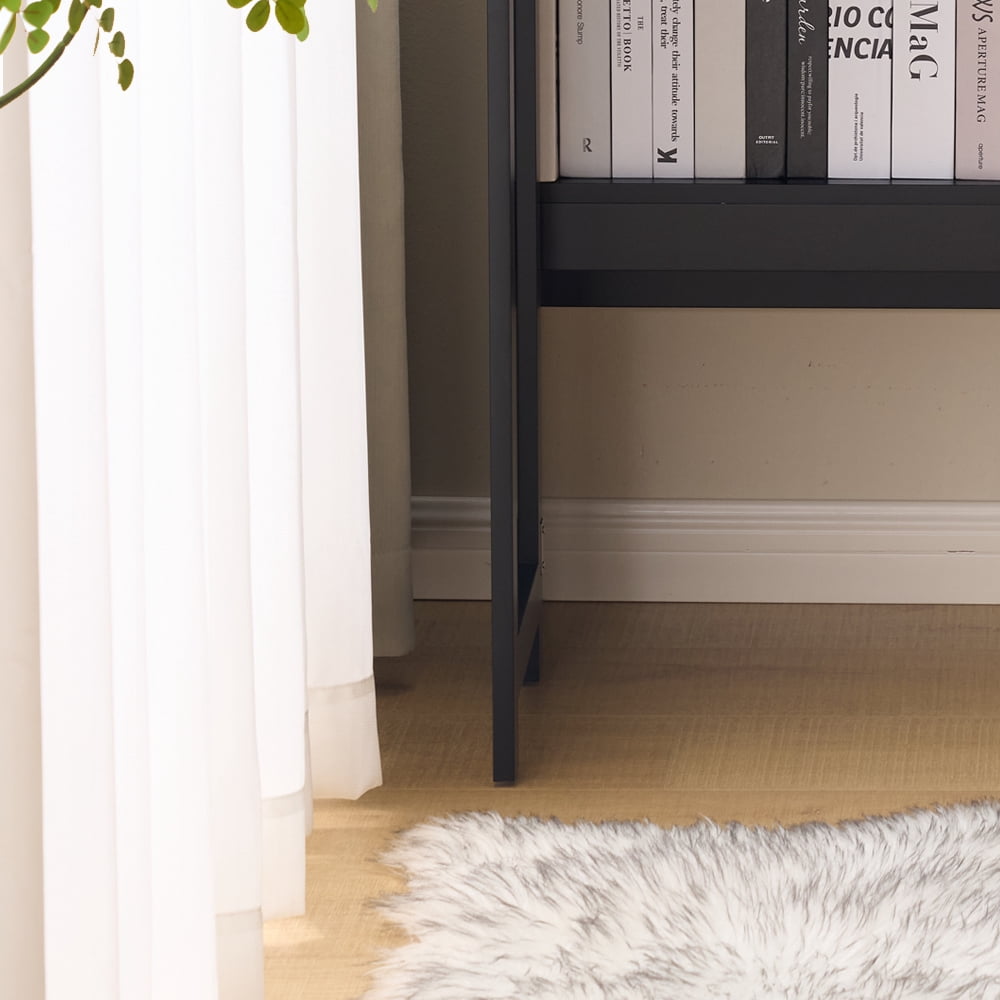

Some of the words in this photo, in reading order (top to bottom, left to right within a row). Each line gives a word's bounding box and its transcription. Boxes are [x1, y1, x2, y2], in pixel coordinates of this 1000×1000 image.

[660, 6, 669, 25] treat
[576, 22, 585, 45] Stump
[660, 29, 669, 49] their
[670, 17, 681, 47] change
[908, 1, 939, 82] MaG
[623, 38, 632, 72] BOOK
[671, 50, 680, 71] their
[976, 27, 987, 92] APERTURE
[671, 72, 680, 106] attitude
[976, 94, 987, 123] MAG
[671, 109, 680, 142] towards
